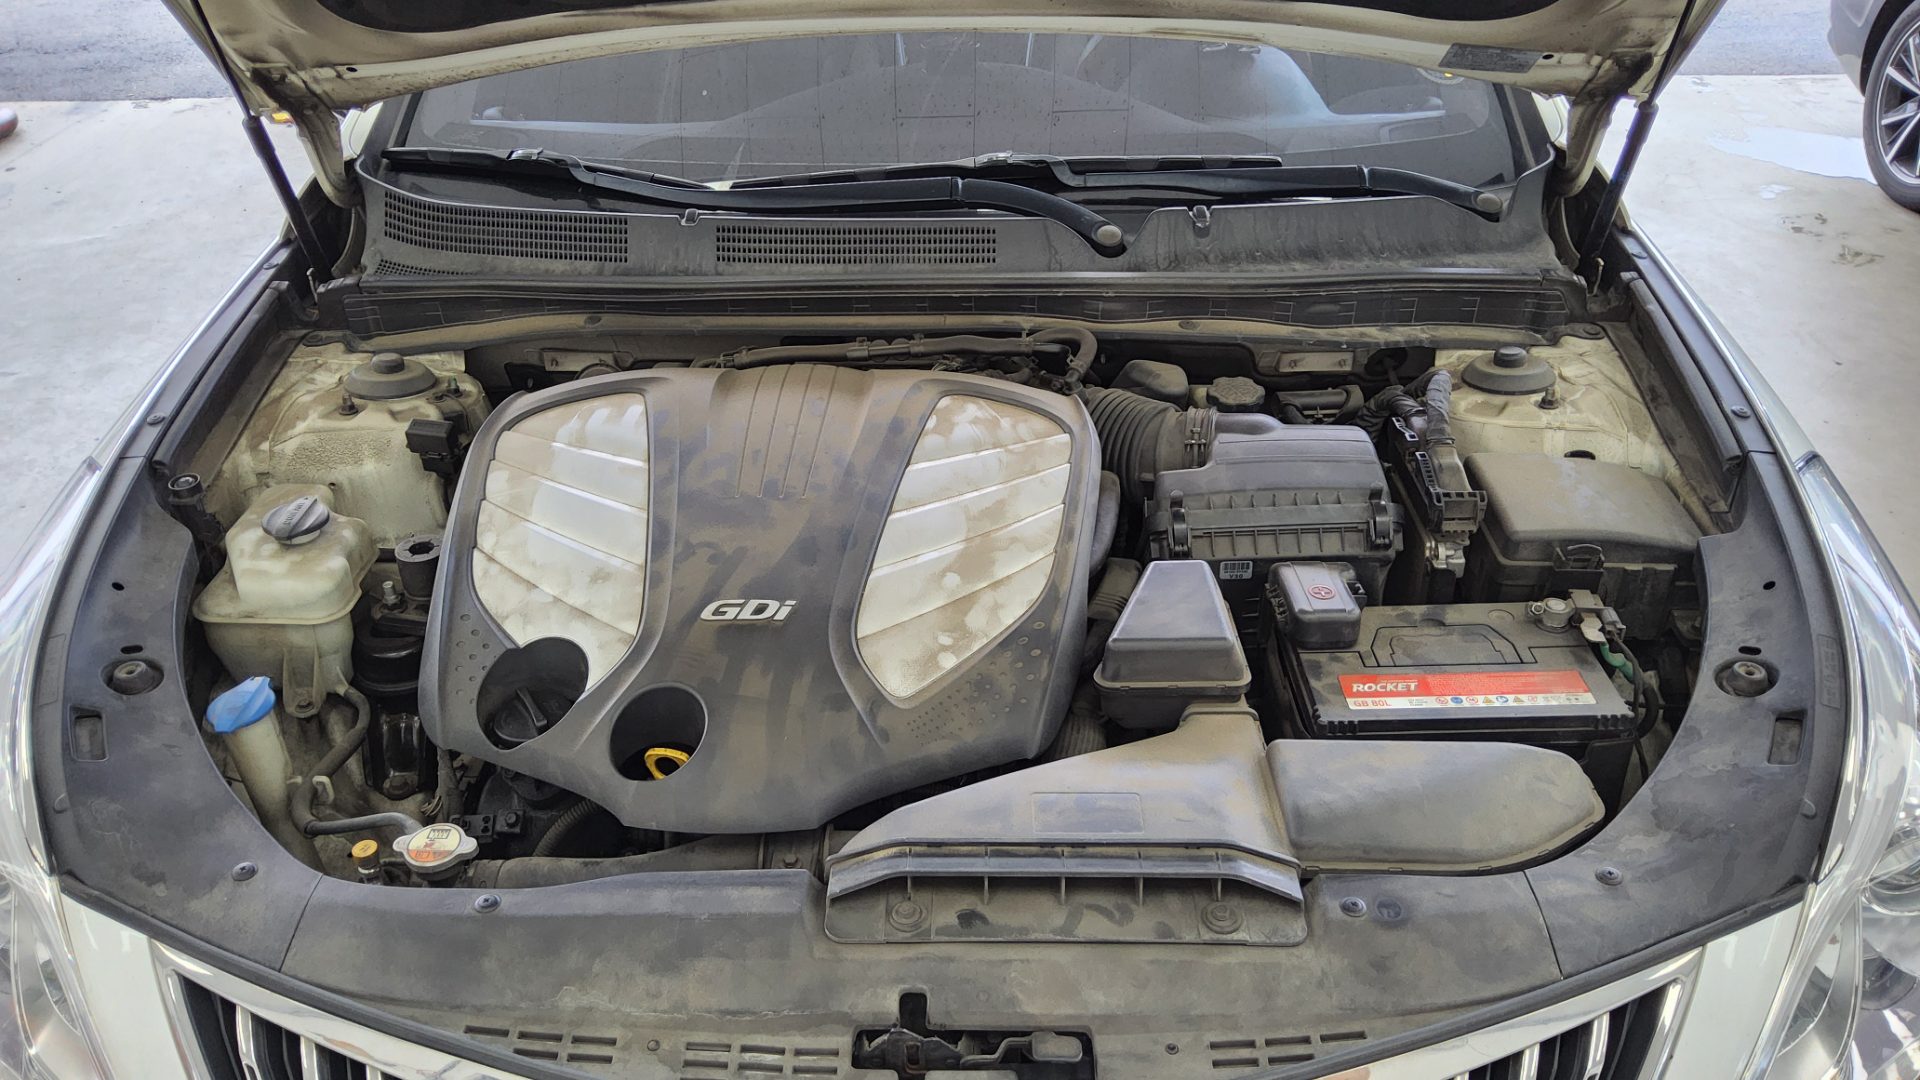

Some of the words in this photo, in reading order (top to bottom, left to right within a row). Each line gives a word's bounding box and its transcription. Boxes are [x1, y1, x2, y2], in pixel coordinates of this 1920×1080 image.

[700, 599, 797, 620] GDi
[1352, 682, 1418, 692] ROCKET
[1353, 699, 1369, 707] GB
